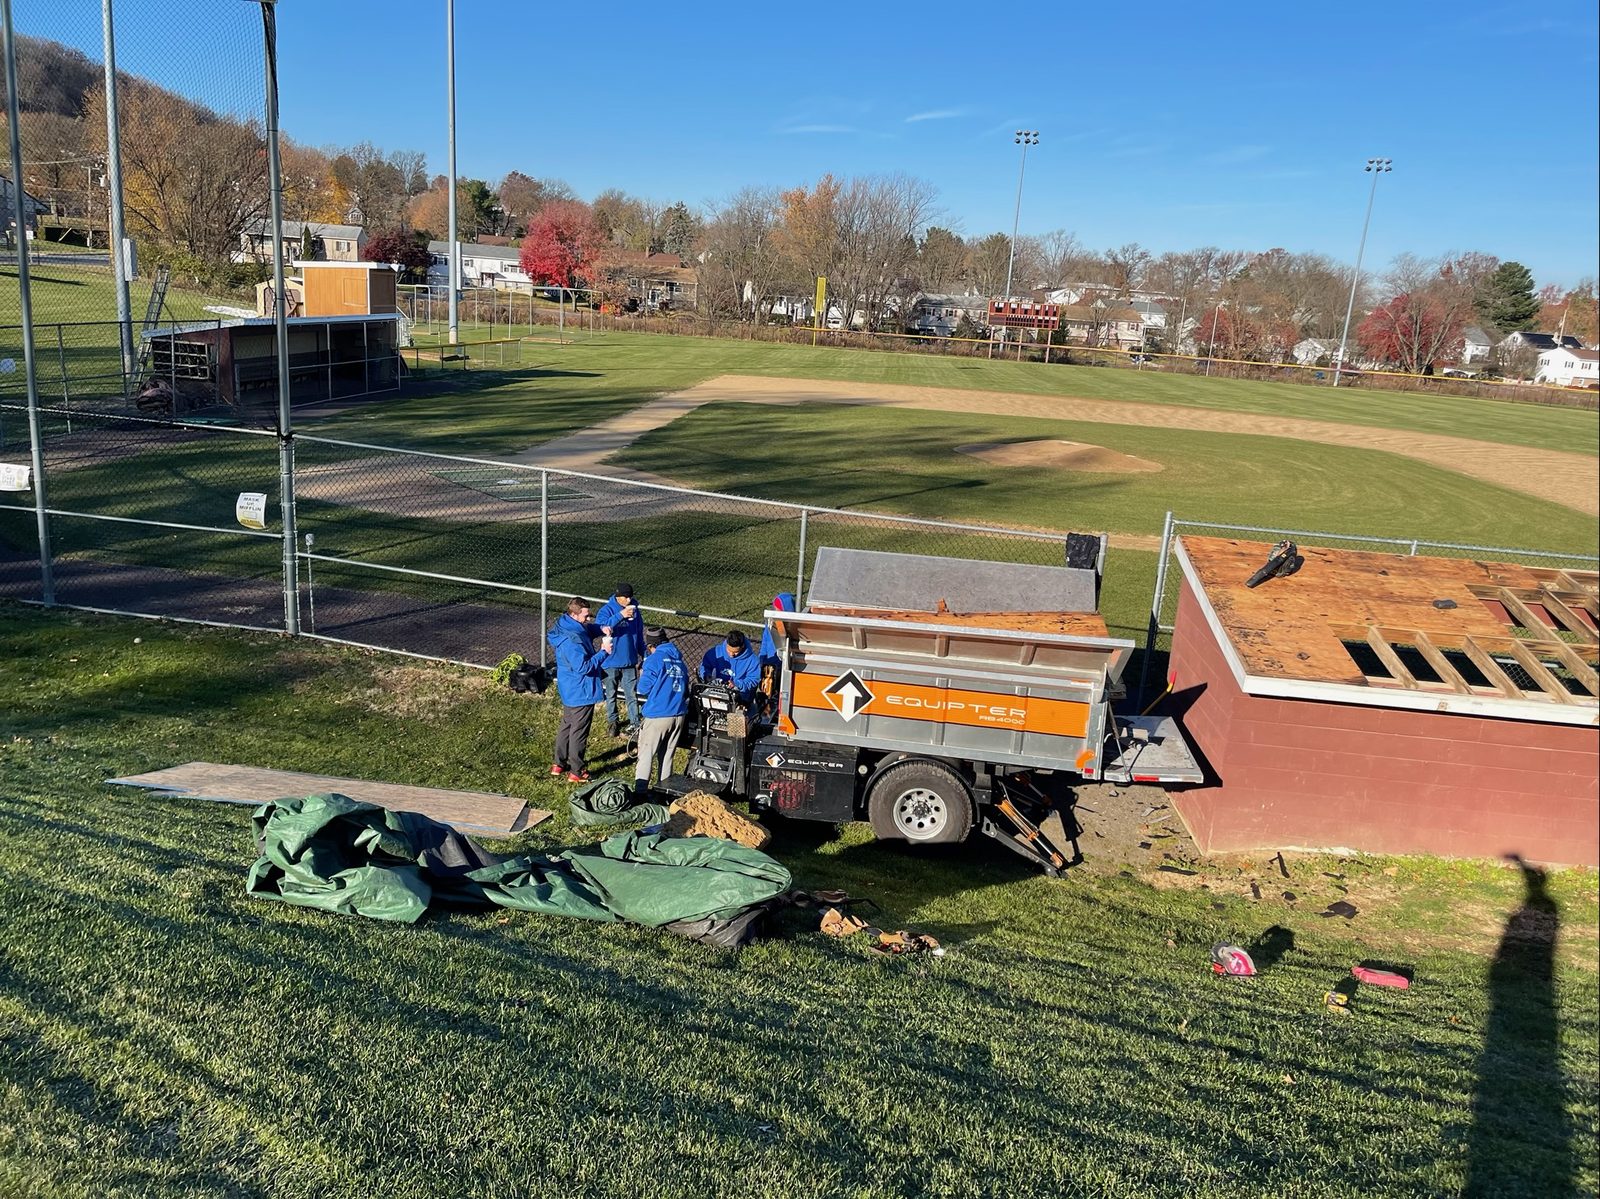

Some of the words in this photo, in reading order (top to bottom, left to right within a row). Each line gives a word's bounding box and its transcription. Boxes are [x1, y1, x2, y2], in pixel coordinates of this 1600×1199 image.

[886, 695, 1027, 719] EQUIPTER
[978, 715, 1026, 725] RB4000
[787, 758, 844, 769] EQUIPTER
